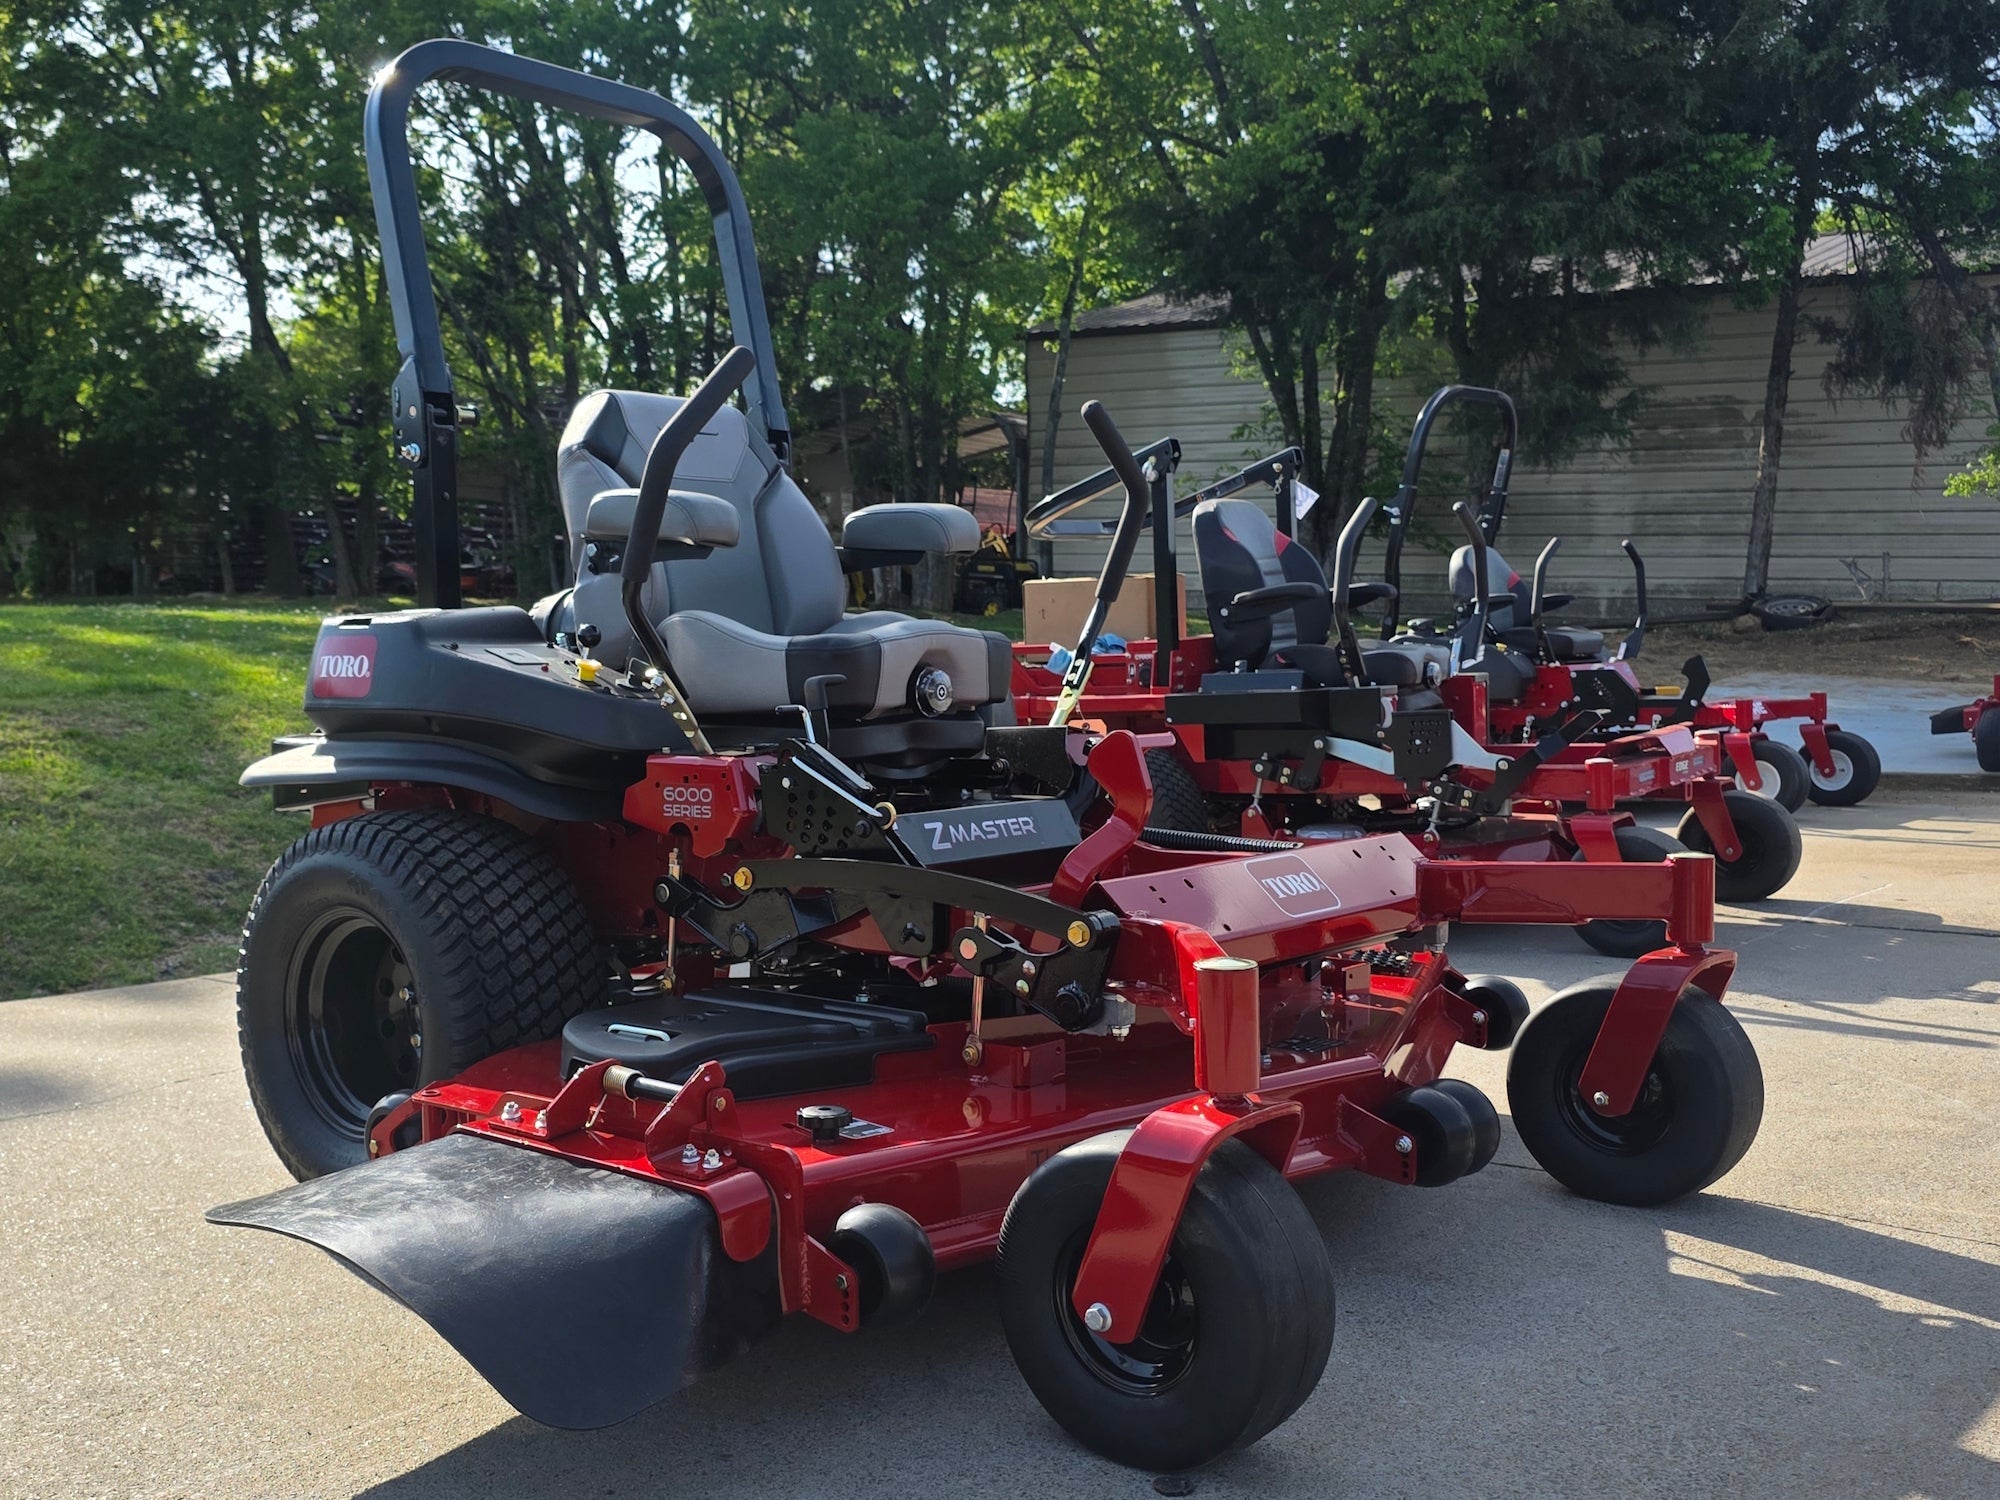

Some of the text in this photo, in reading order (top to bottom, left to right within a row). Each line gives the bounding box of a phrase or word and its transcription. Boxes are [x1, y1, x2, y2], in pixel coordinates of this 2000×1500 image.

[320, 654, 370, 678] TORO
[1675, 760, 1689, 772] EDGE
[663, 786, 712, 802] 6000
[663, 804, 712, 818] SERIES
[1260, 871, 1320, 898] TORO
